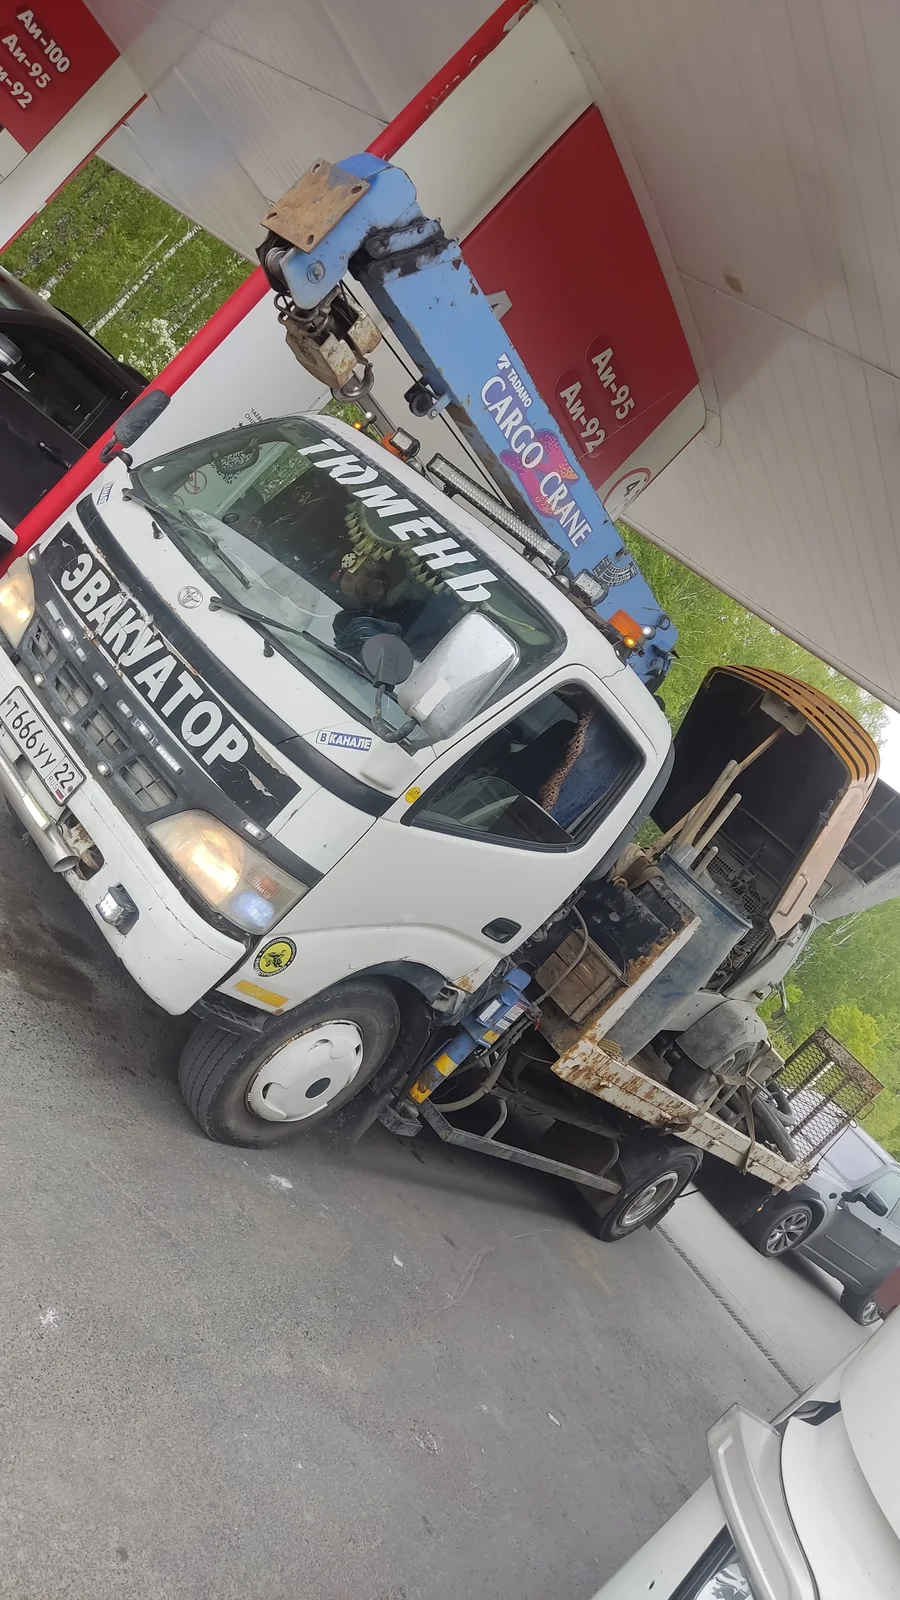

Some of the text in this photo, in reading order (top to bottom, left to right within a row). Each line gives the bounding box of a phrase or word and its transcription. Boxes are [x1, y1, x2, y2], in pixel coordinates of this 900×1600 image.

[1, 33, 52, 88] Аи-95
[16, 9, 71, 73] Аи-100
[0, 65, 33, 109] и-92
[507, 368, 532, 408] TADANO
[591, 347, 636, 420] Аи-95
[559, 380, 606, 454] Аи-92
[481, 376, 544, 469] CARGO
[539, 471, 594, 548] CRANE
[297, 438, 499, 602] ТЮМЕНЬ
[61, 553, 249, 766] ЭВАКУАТОР
[329, 733, 373, 750] КАНАЛЕ
[53, 762, 75, 789] 22
